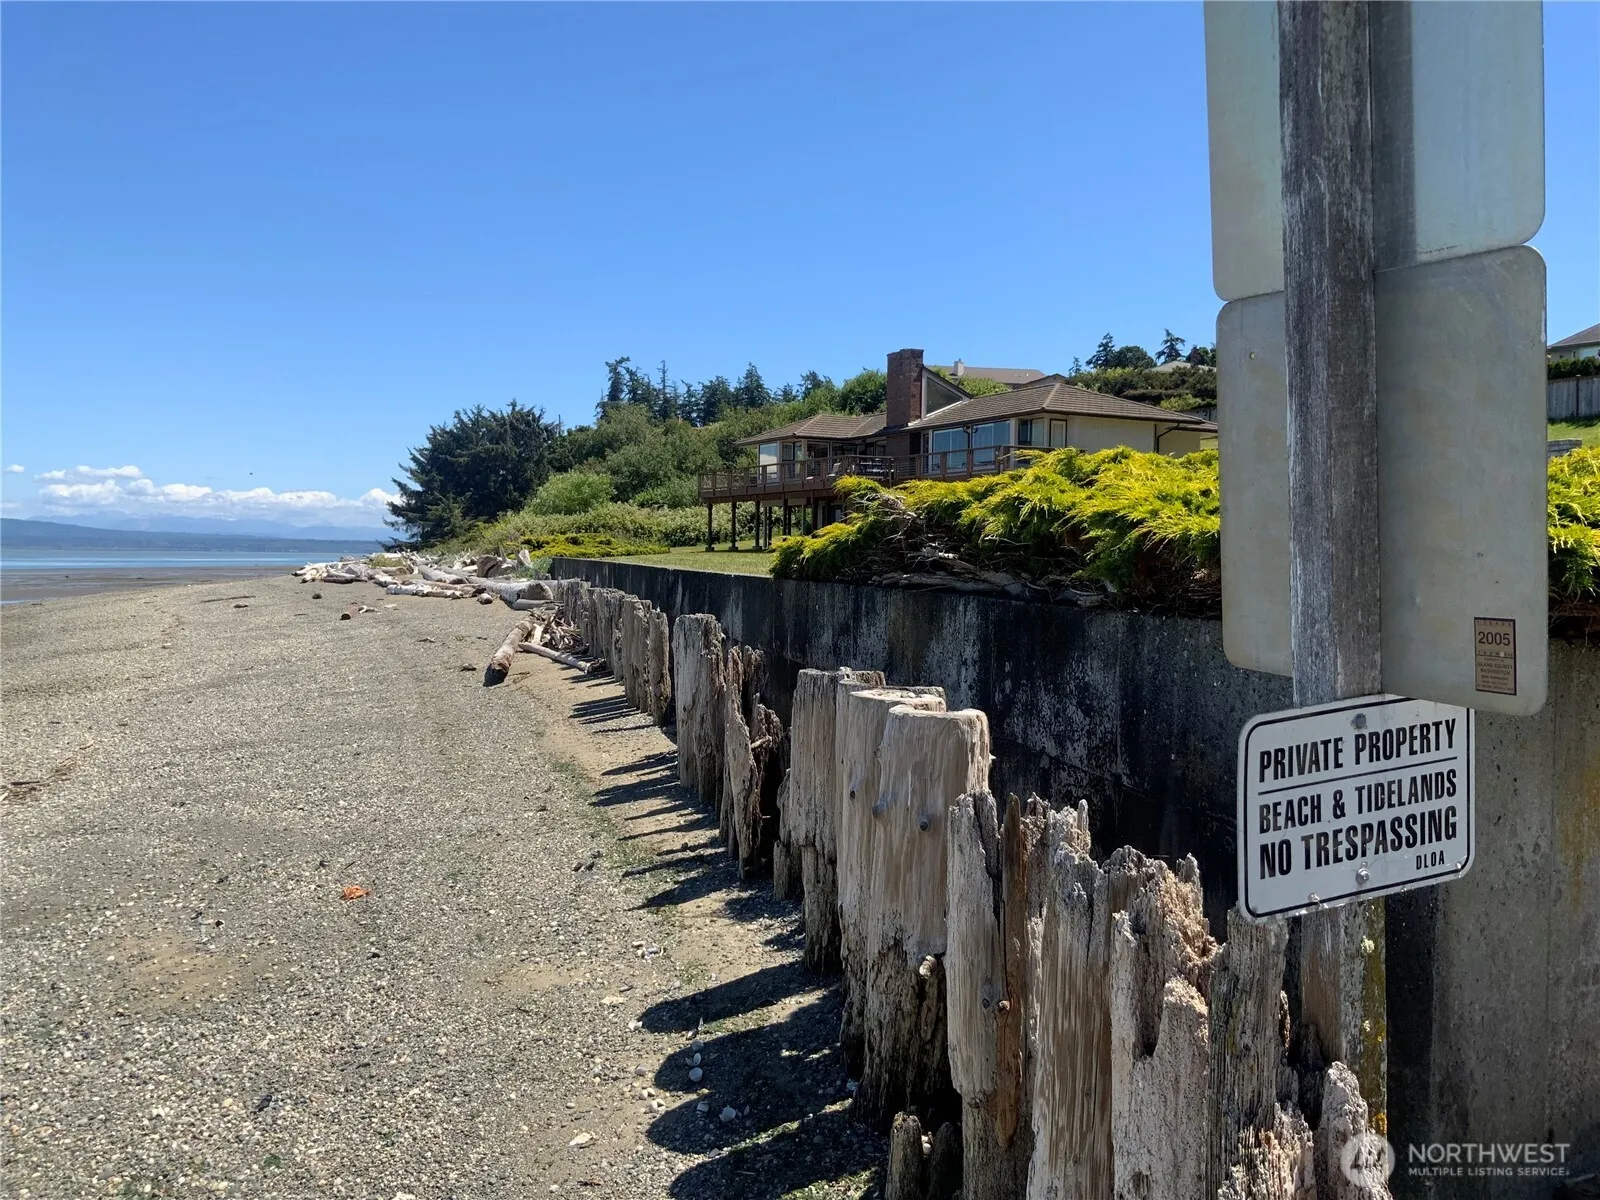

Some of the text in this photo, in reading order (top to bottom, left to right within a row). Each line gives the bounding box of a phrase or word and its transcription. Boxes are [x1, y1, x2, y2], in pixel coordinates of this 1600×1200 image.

[1478, 631, 1511, 646] 2005
[1259, 718, 1457, 783] PRIVATE PROPERTY
[1259, 768, 1457, 835] BEACH & TIDELANDS
[1259, 805, 1457, 880] NO TRESPASSING
[1416, 850, 1445, 870] DLOA
